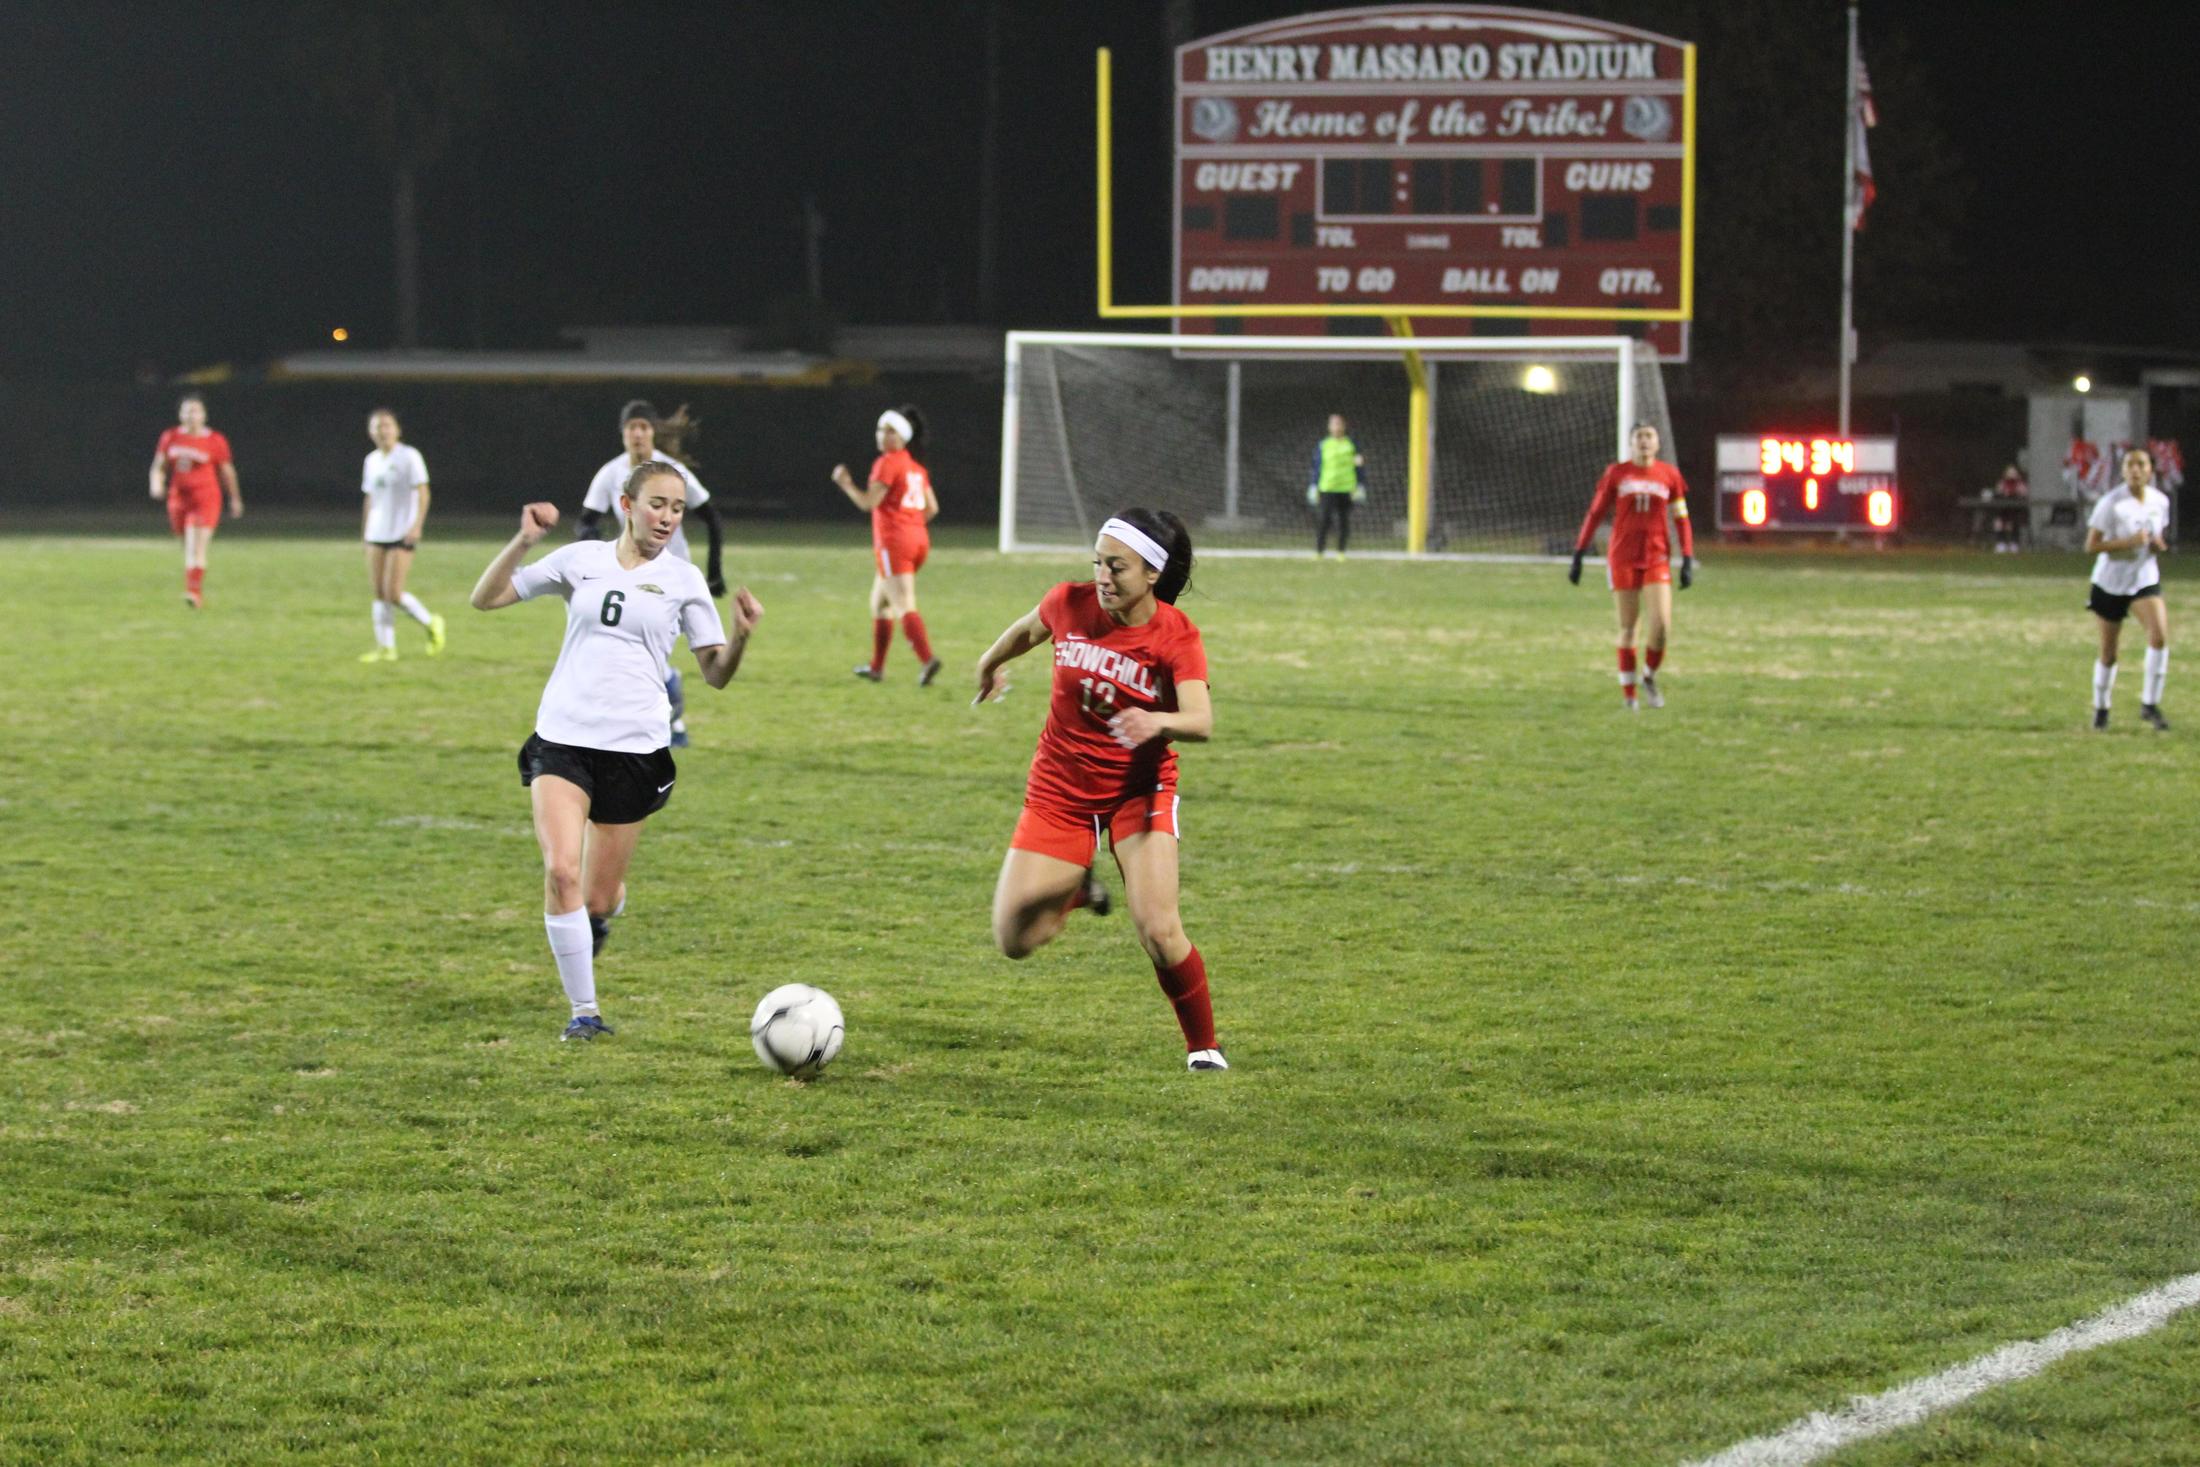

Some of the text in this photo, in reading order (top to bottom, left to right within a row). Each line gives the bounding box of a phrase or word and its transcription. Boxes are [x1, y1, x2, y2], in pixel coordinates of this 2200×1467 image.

[1206, 43, 1656, 80] HENRY MASSARO STADIUM
[1249, 98, 1615, 146] Home of the Tribe!
[1195, 162, 1302, 192] GUEST
[1188, 266, 1270, 293] DOWN
[1317, 266, 1396, 292] TO GO
[1441, 266, 1560, 293] BALL ON
[1599, 267, 1663, 296] QTR.
[1742, 489, 1767, 525] 0
[1868, 490, 1893, 526] 0
[600, 590, 626, 627] 6
[1079, 677, 1116, 714] 12
